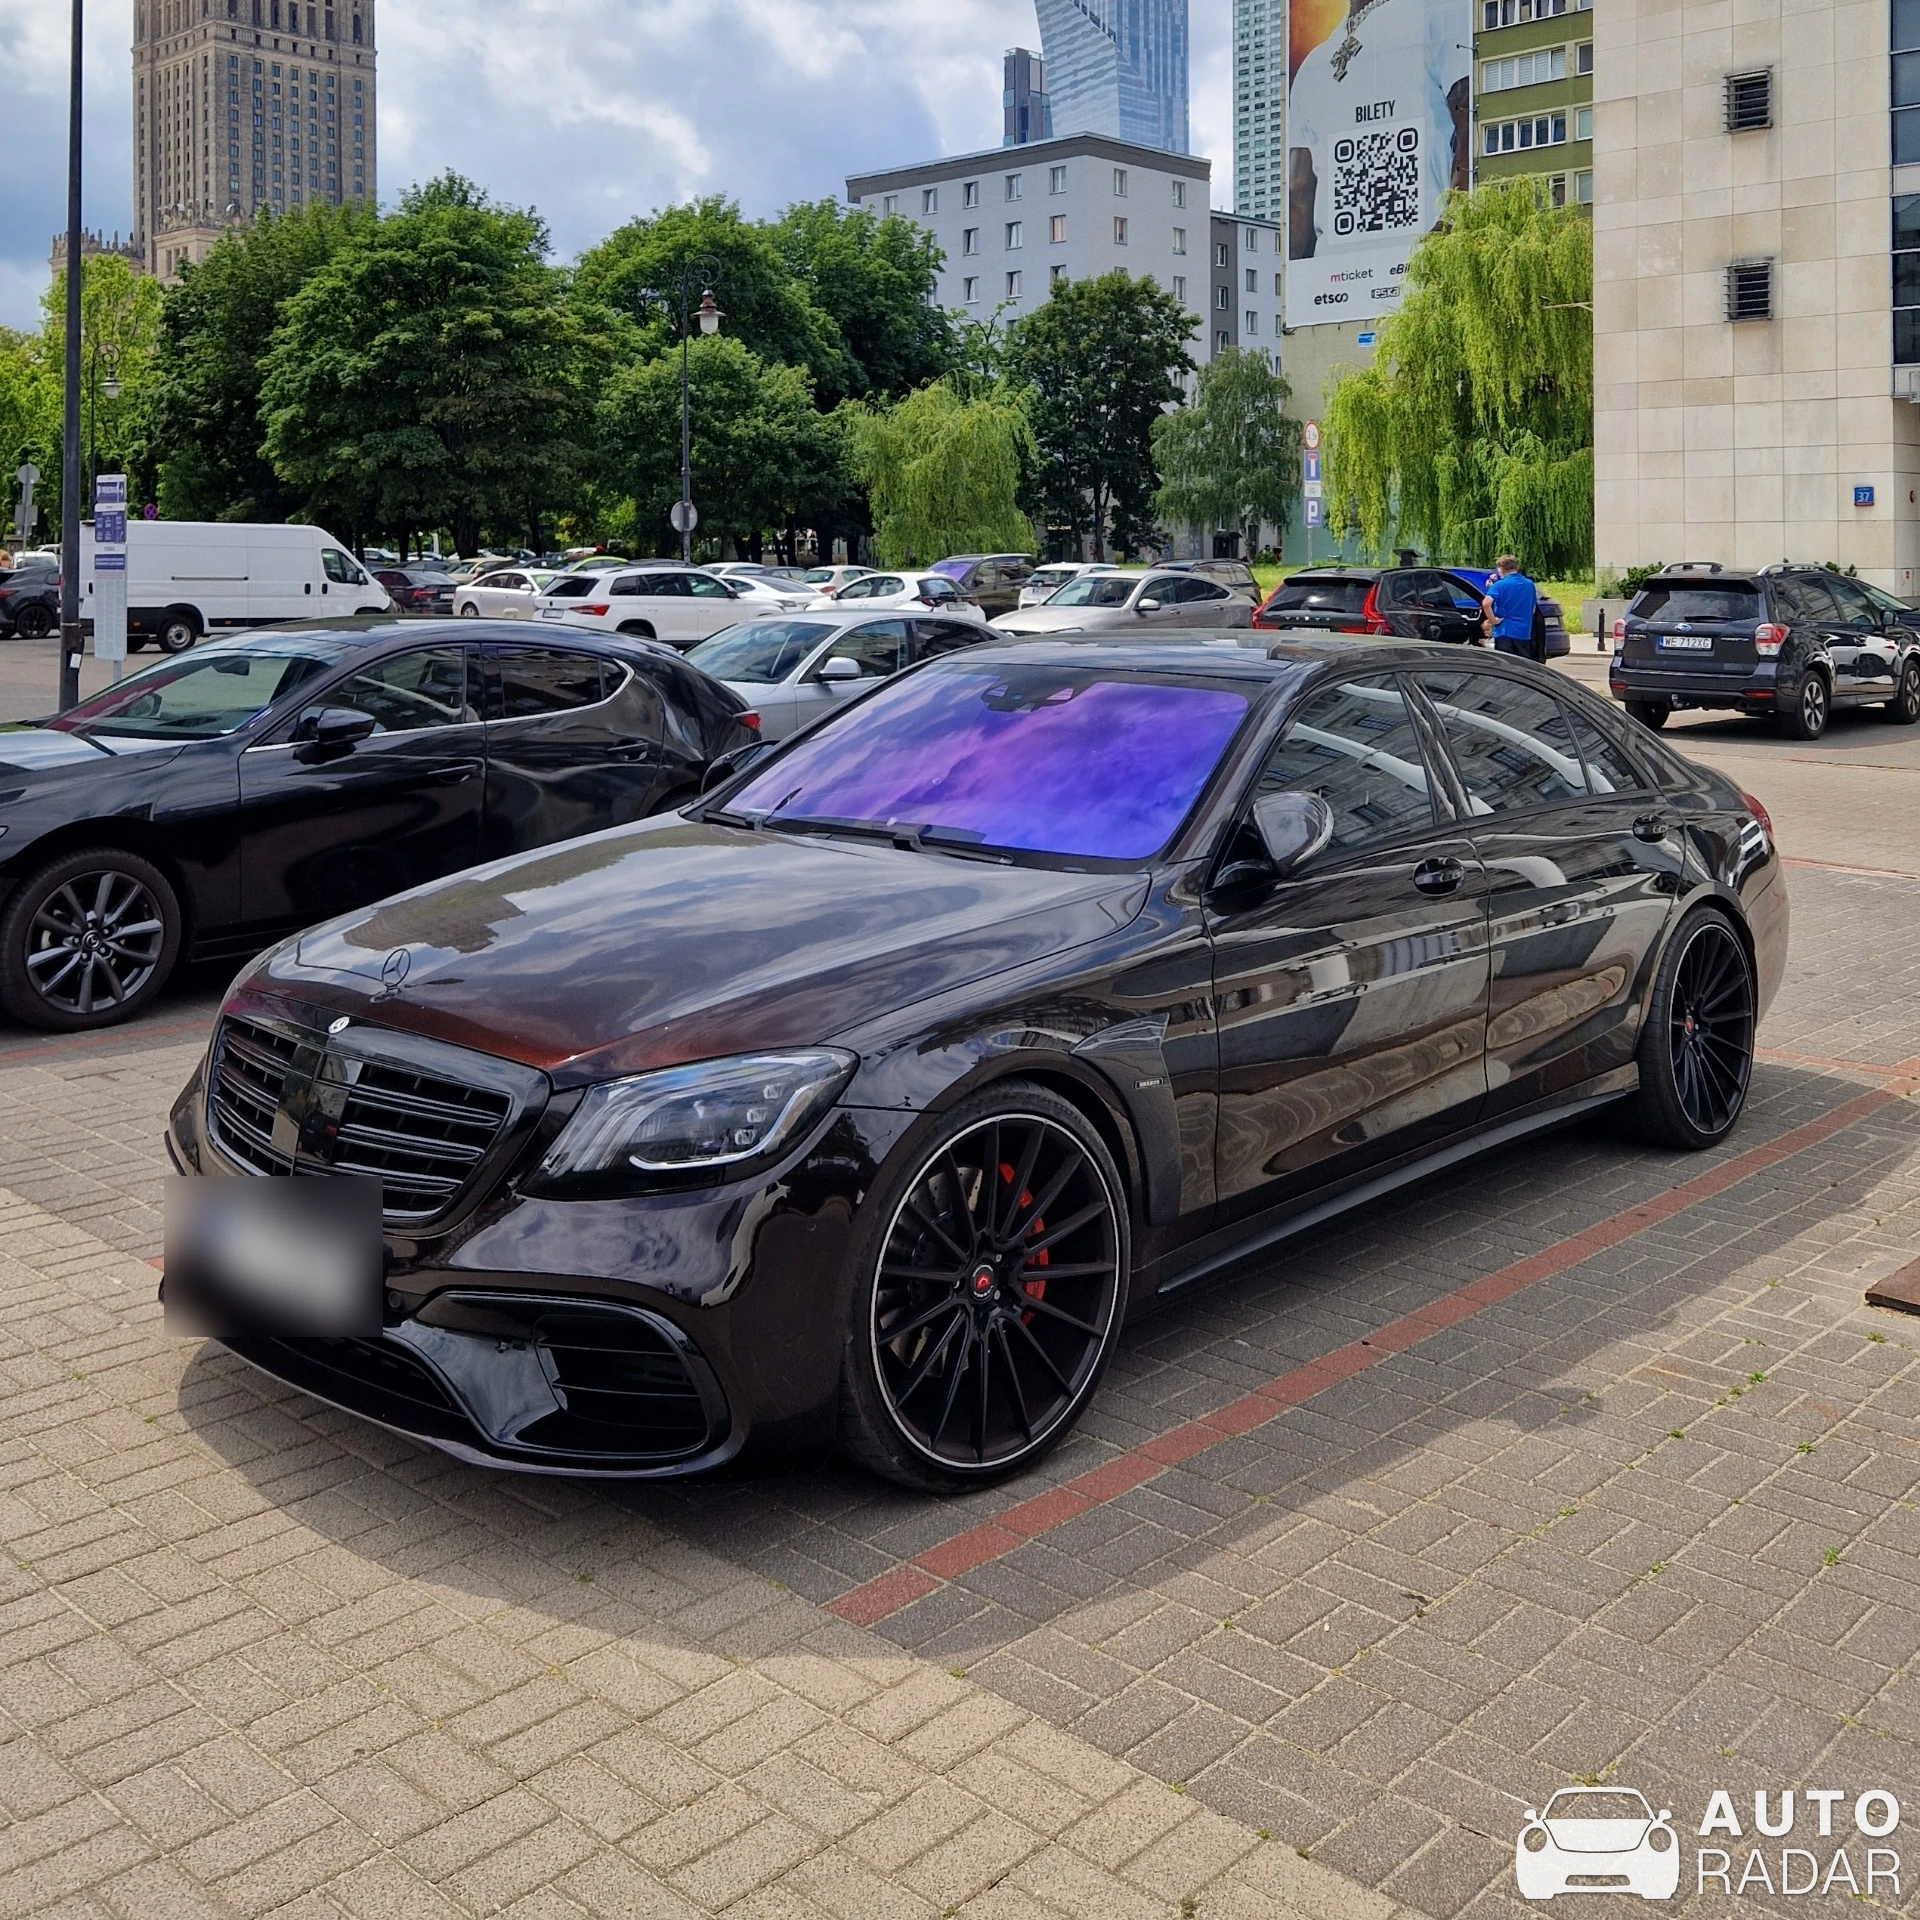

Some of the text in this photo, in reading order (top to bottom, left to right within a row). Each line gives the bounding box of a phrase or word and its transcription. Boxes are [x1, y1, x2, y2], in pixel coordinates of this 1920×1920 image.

[1355, 100, 1396, 123] BILETY
[1389, 263, 1411, 275] eBil
[1331, 268, 1374, 283] mticket
[1857, 491, 1870, 502] 37
[1665, 637, 1677, 647] WE
[1680, 638, 1709, 648] 712XG
